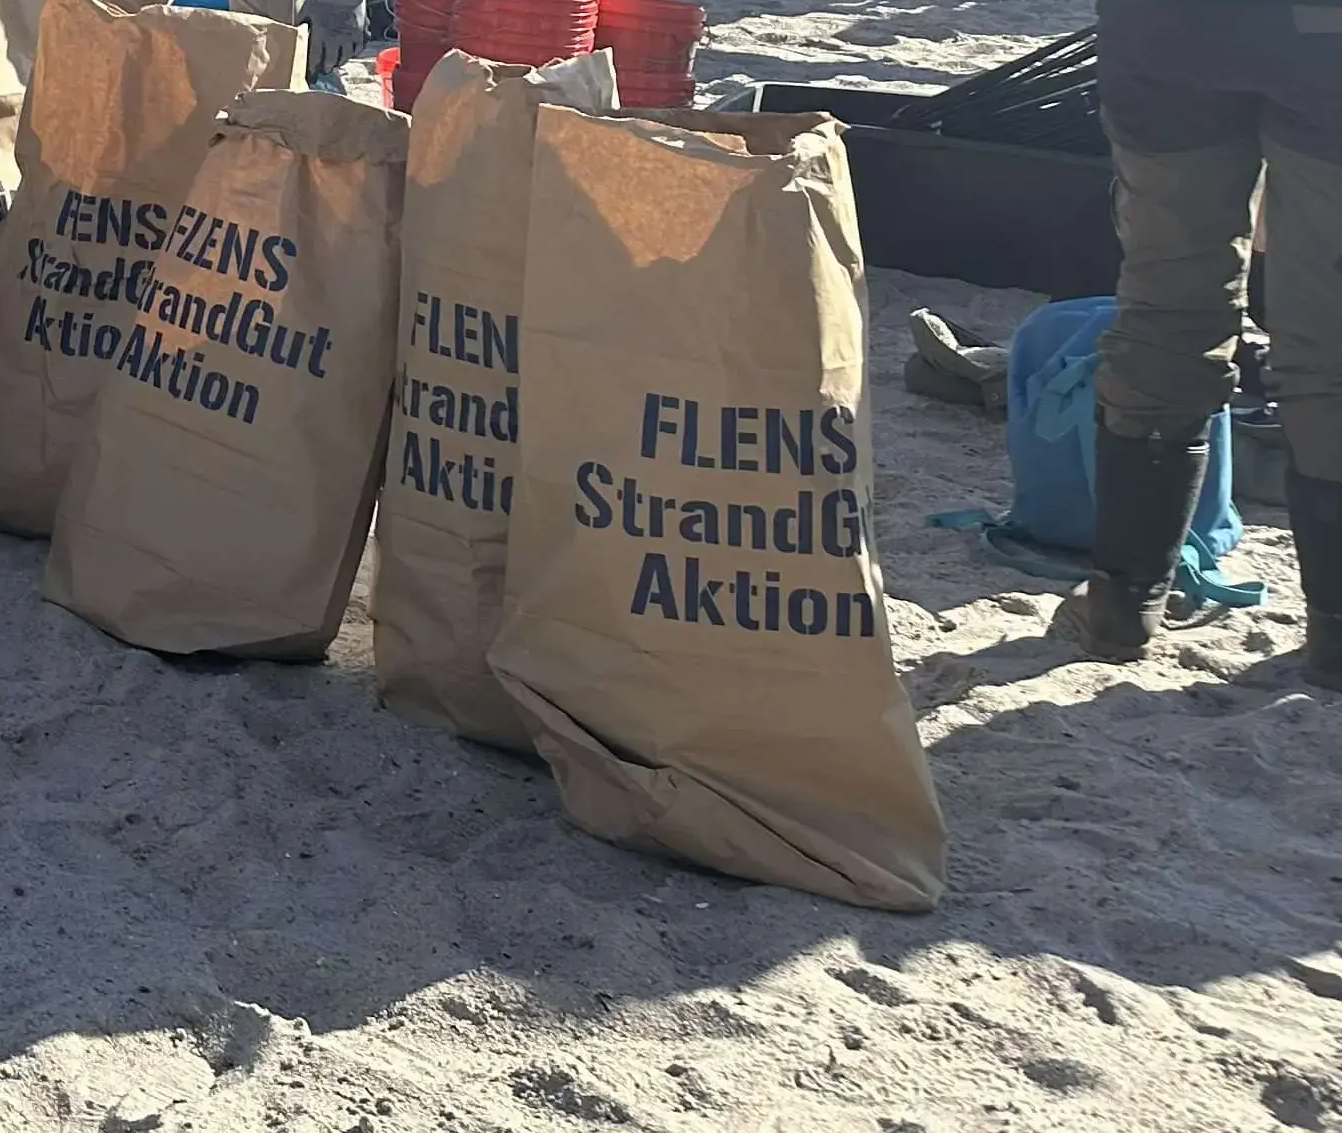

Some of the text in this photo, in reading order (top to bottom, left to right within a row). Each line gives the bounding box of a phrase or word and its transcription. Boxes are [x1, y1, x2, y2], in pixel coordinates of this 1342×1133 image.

[116, 323, 260, 425] Aktion
[410, 291, 519, 374] FLEN
[641, 392, 858, 476] FLENS
[575, 461, 867, 558] StrandG
[630, 552, 875, 638] Aktion
